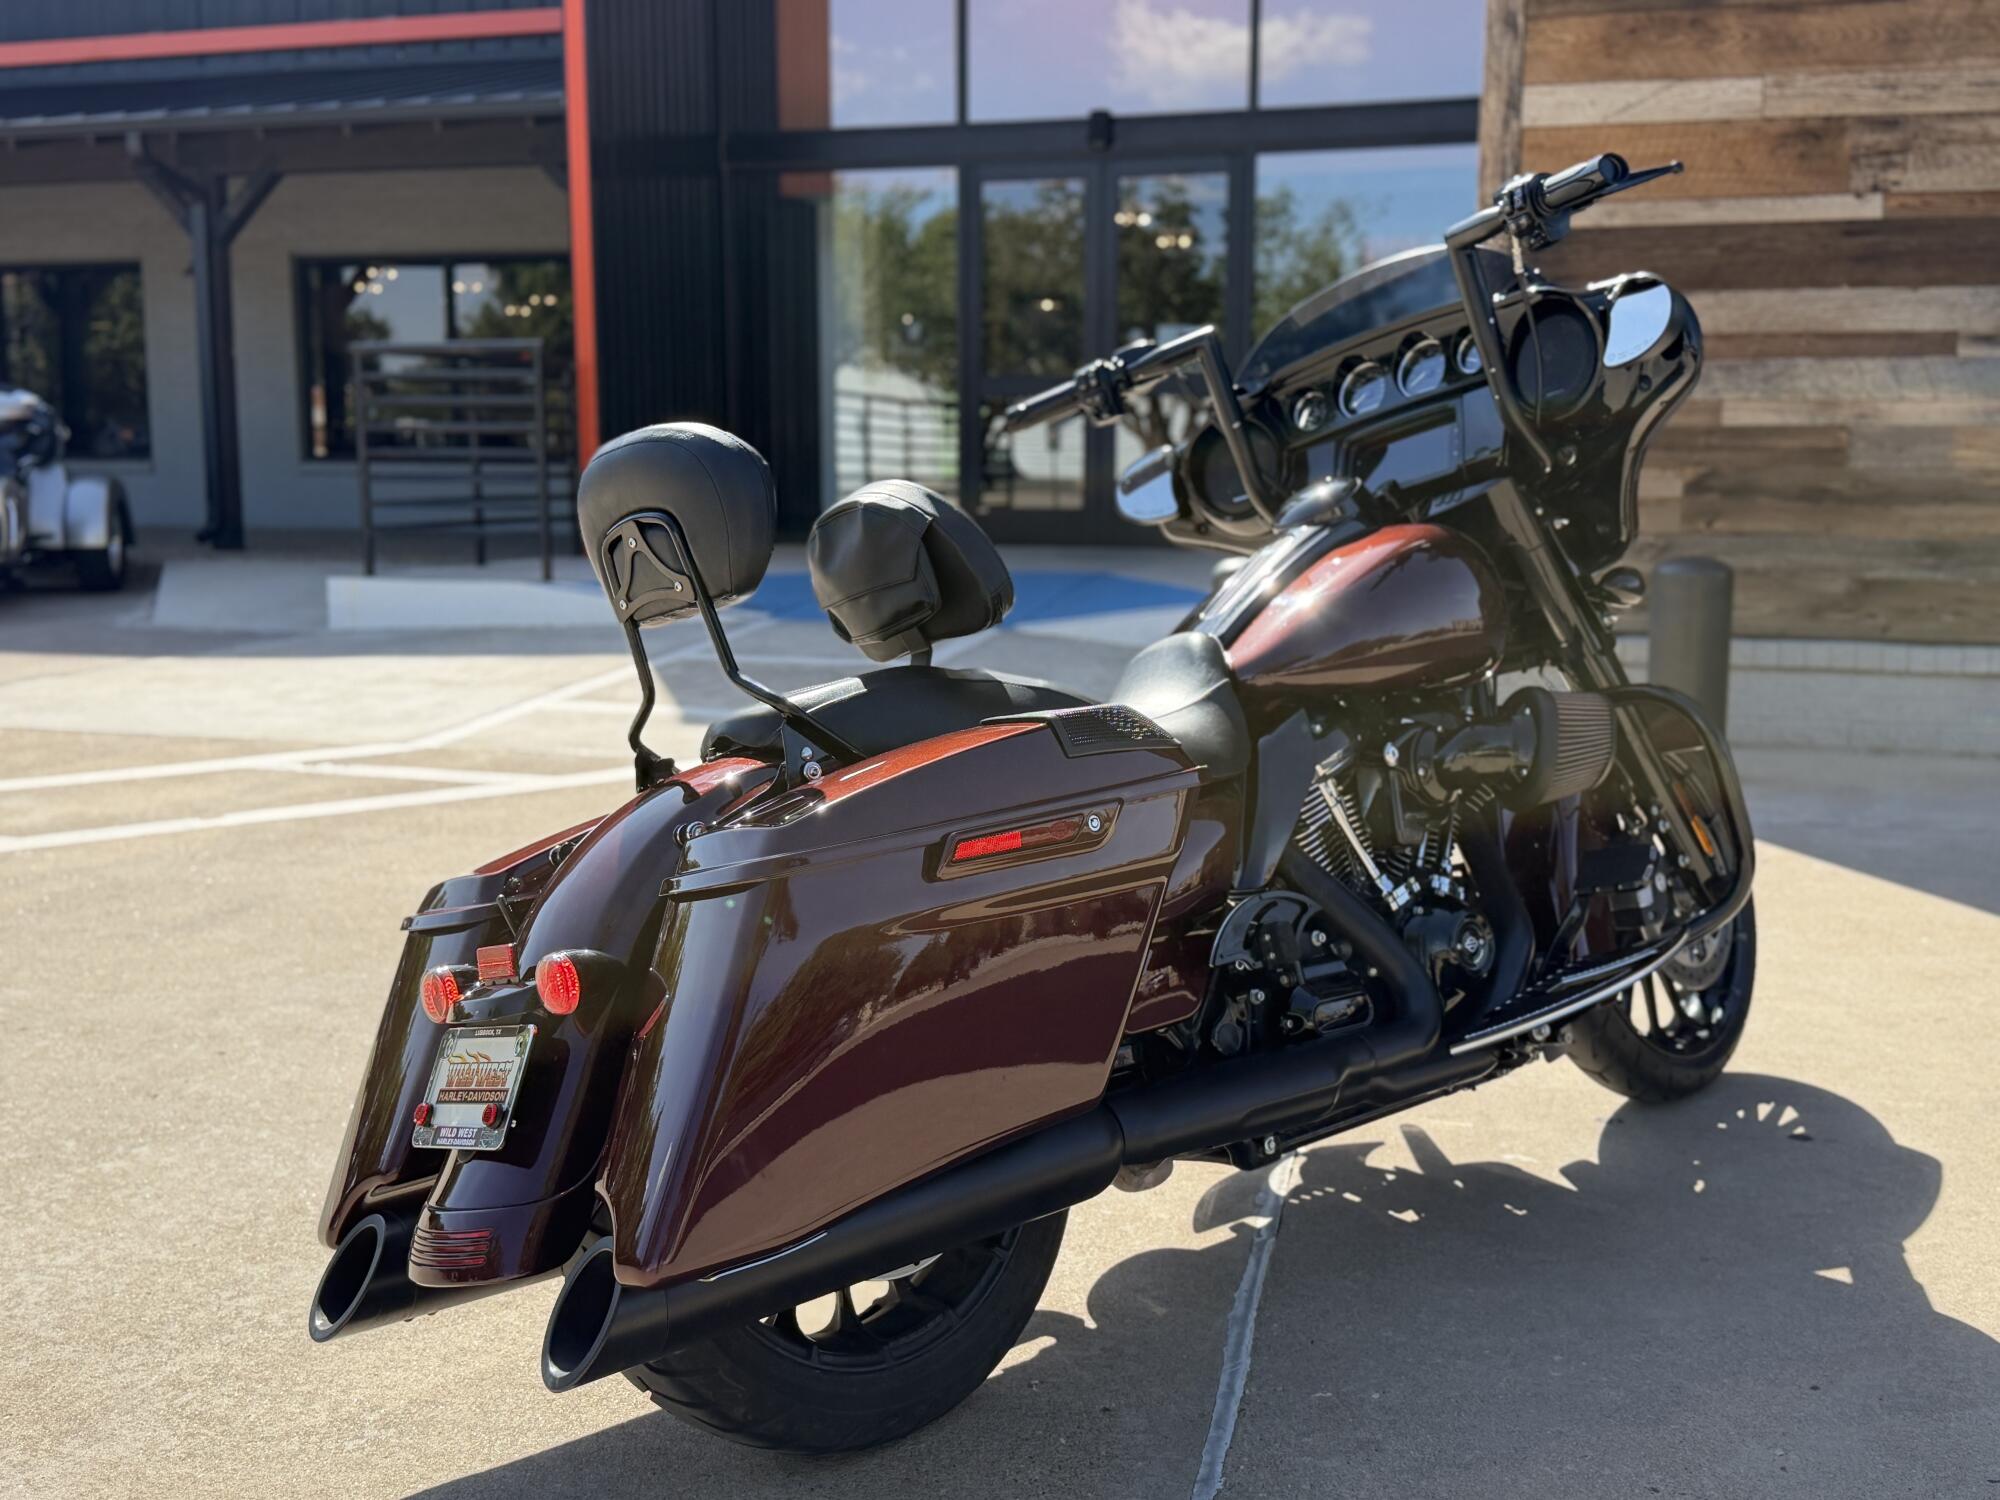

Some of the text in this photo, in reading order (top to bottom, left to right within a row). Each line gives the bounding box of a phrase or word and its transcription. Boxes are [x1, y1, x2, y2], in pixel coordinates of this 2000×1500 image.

[446, 1060, 514, 1087] WILD WEST
[439, 1091, 507, 1101] HARLEY-DAVIDSON
[440, 1127, 478, 1138] WILD WEST
[436, 1138, 476, 1146] HARLEY-DAVIDSON
